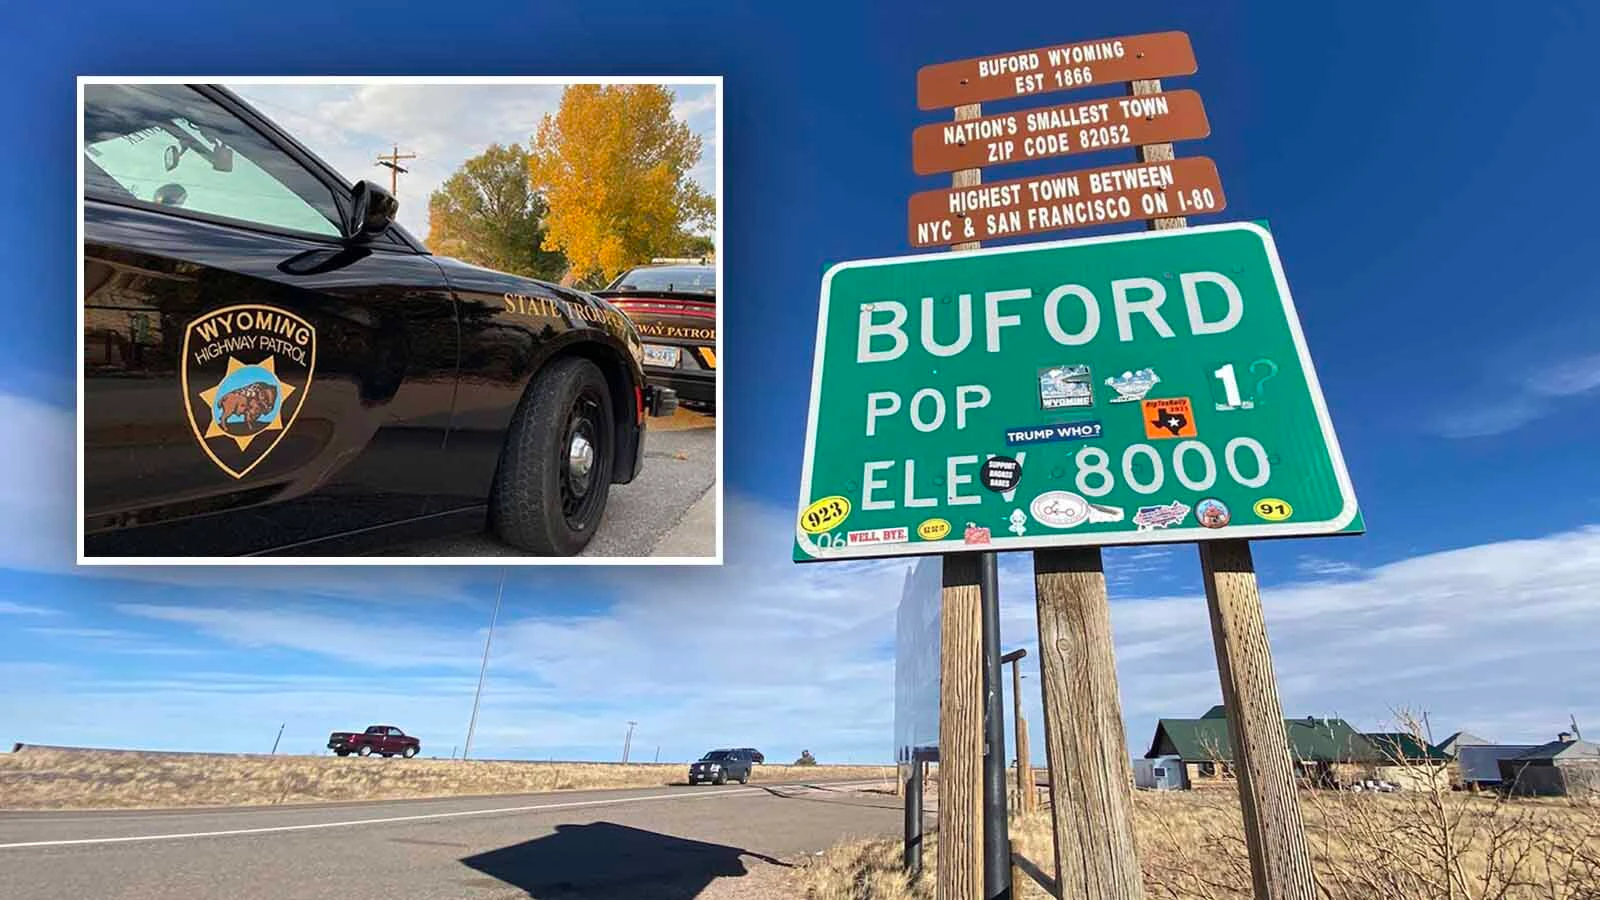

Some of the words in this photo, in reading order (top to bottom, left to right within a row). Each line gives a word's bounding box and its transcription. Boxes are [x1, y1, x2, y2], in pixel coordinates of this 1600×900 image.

[979, 52, 1039, 77] BUFORD
[1048, 41, 1124, 67] WYOMING
[1015, 72, 1043, 94] EST
[1055, 66, 1093, 88] 1866
[943, 116, 1017, 145] NATION'S
[1027, 104, 1109, 132] SMALLEST
[1119, 96, 1169, 119] TOWN
[988, 141, 1013, 162] ZIP
[1024, 134, 1070, 157] CODE
[1079, 125, 1131, 148] 82052
[949, 184, 1021, 213] HIGHEST
[1028, 176, 1080, 202] TOWN
[1090, 165, 1174, 194] BETWEEN
[917, 219, 952, 244] NYC
[963, 217, 975, 238] &
[986, 210, 1022, 235] SAN
[1028, 195, 1131, 230] FRANCISCO
[1141, 191, 1168, 214] ON
[1179, 187, 1215, 213] I-80
[504, 292, 562, 318] STATE
[856, 271, 1244, 364] BUFORD
[196, 311, 310, 346] WYOMING
[636, 322, 665, 335] WAY
[194, 335, 258, 366] HIGHWAY
[259, 335, 308, 368] PATROL
[866, 384, 992, 436] POP
[1007, 429, 1054, 443] TRUMP
[1057, 424, 1101, 439] WHO?
[1074, 436, 1271, 498] 8000
[808, 502, 843, 528] 923
[1259, 503, 1286, 516] 91
